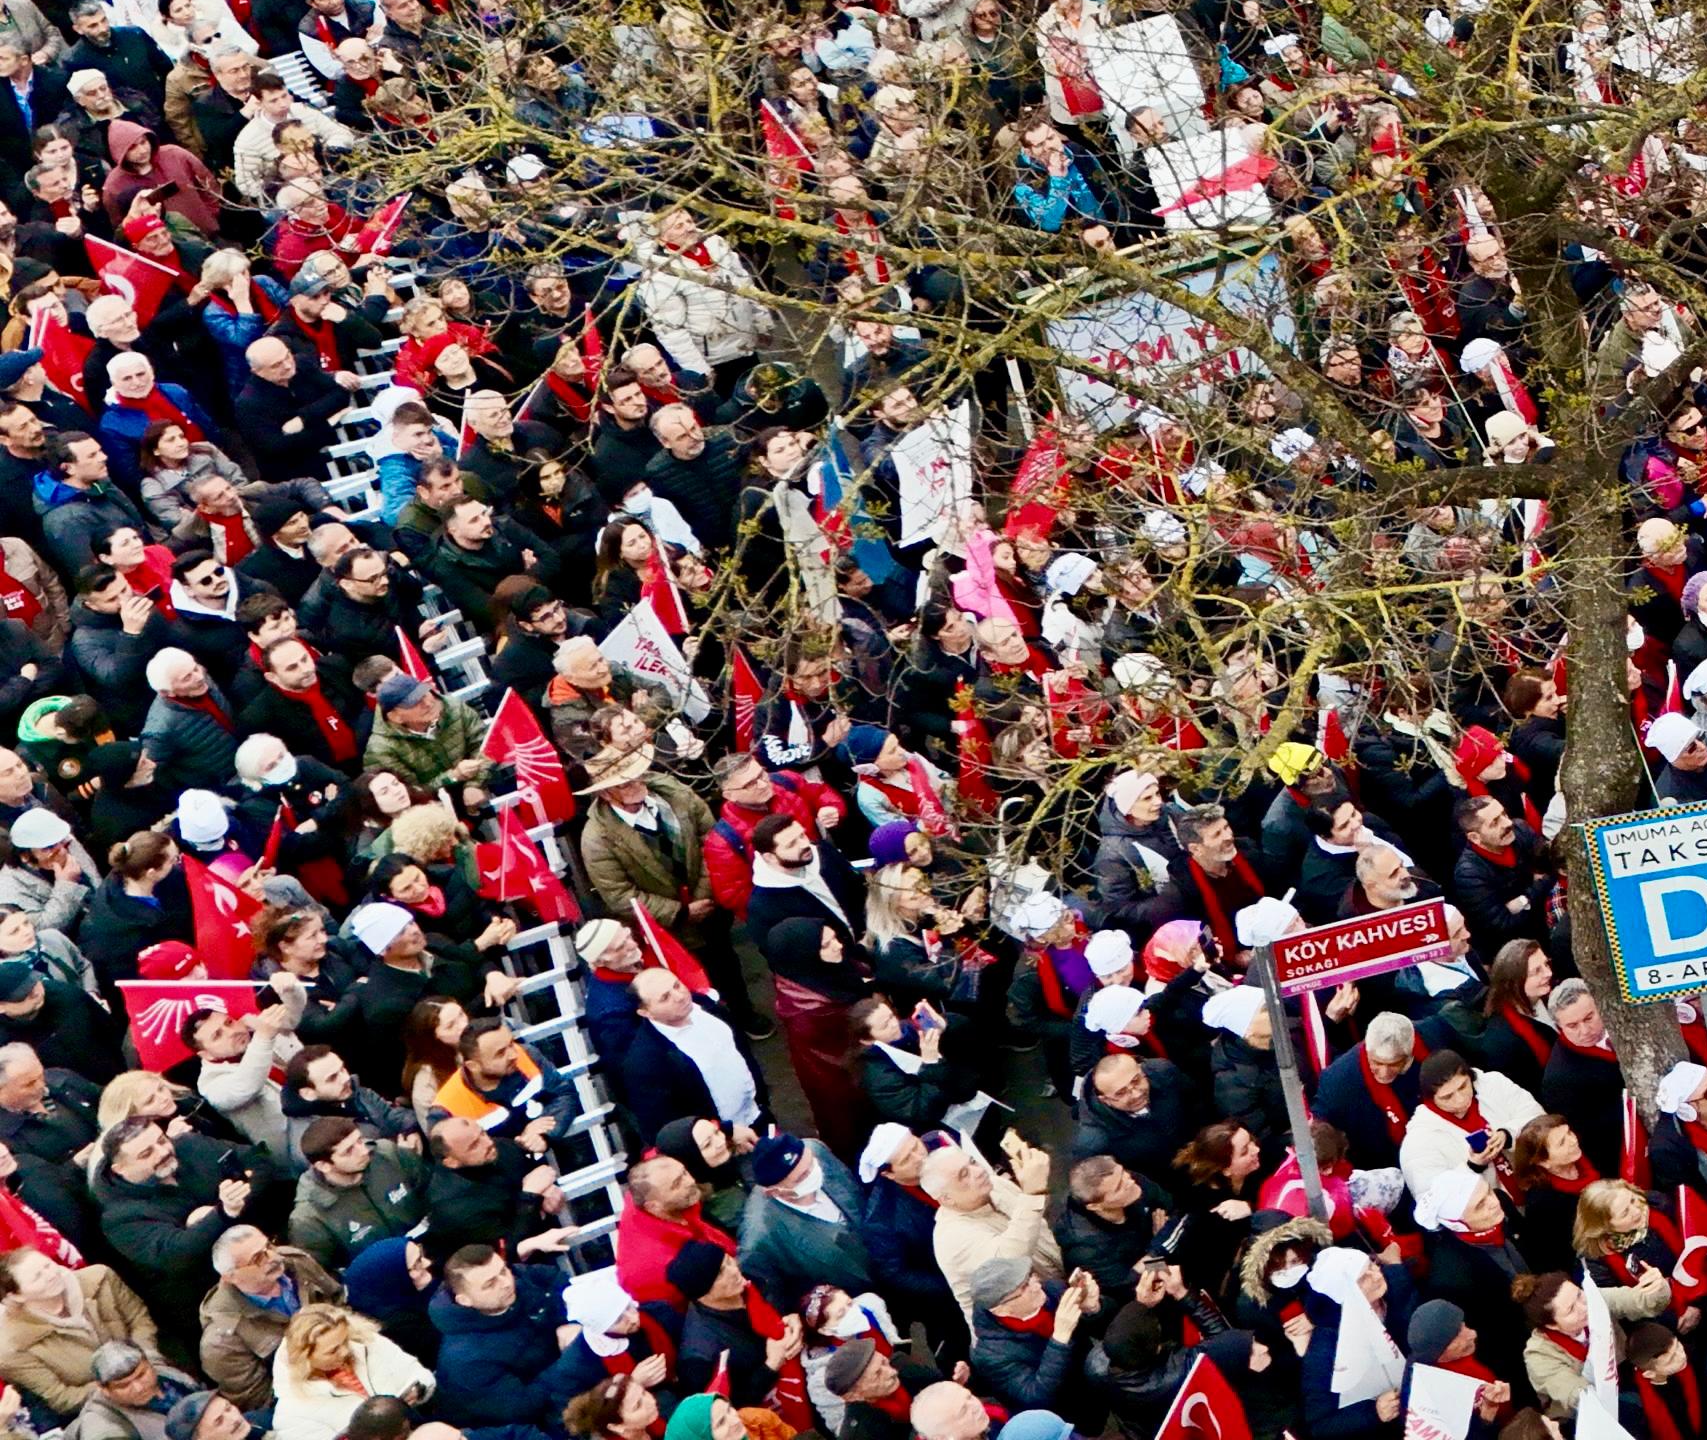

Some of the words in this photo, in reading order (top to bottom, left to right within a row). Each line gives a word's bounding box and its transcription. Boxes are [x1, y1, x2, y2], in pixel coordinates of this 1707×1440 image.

[1608, 824, 1685, 848] UMUMA
[1284, 934, 1334, 964] KÖY
[1337, 909, 1438, 953] KAHVESİ
[1286, 957, 1339, 979] SOKAĞI
